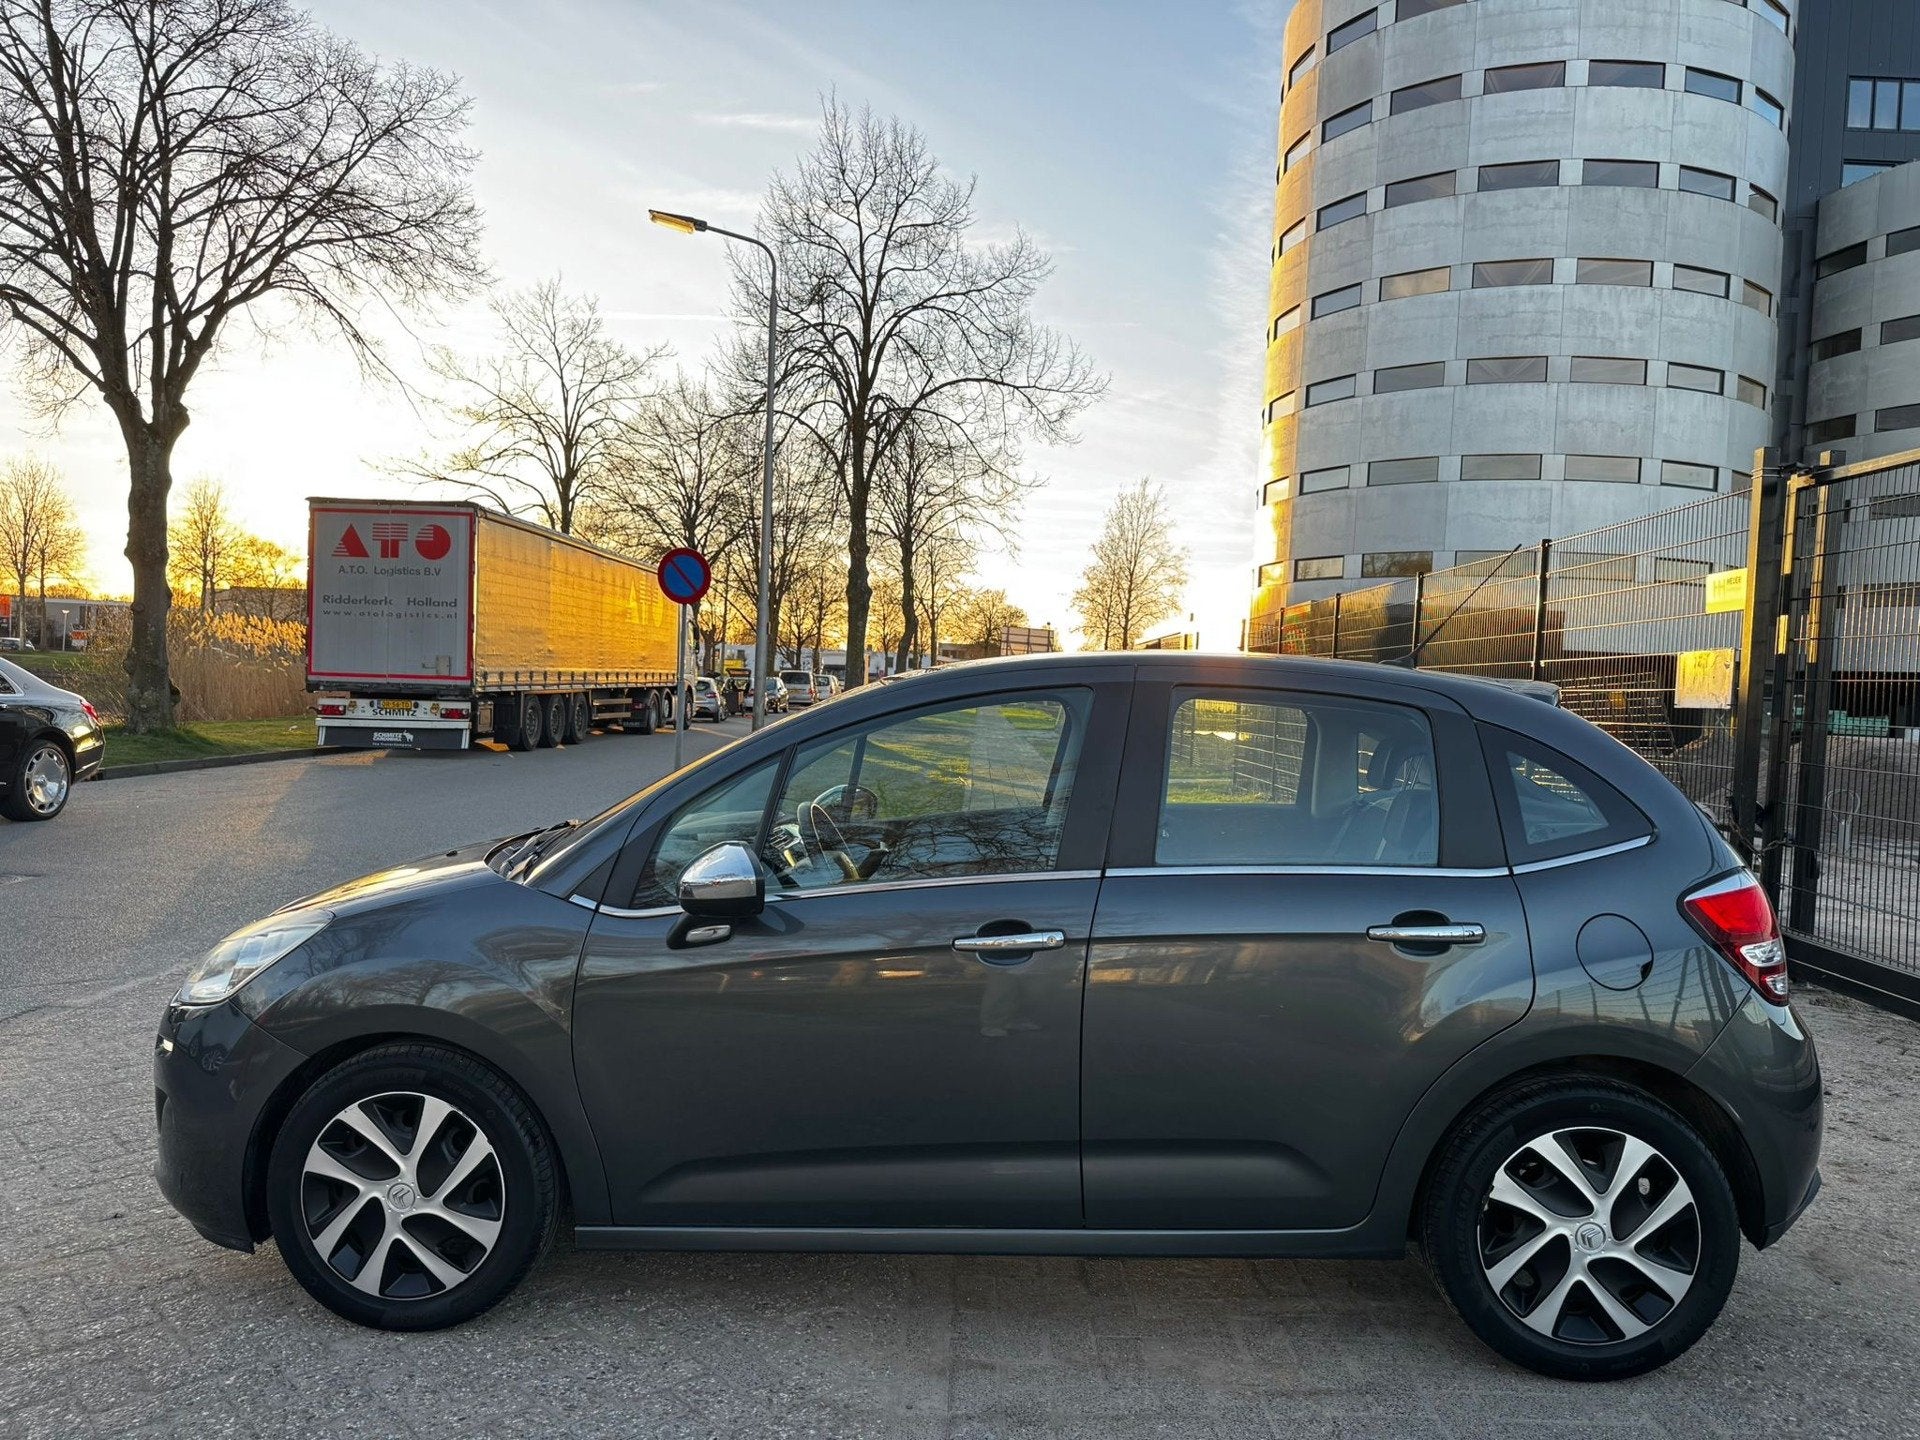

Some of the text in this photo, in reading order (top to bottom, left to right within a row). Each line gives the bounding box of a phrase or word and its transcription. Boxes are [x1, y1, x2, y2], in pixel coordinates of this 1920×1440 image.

[331, 522, 452, 560] ATO
[338, 565, 368, 575] A.T.O.
[373, 565, 421, 577] Logistics
[322, 594, 458, 608] Ridderkerk Holland
[322, 609, 458, 619] www.atologistics.nl
[372, 709, 417, 717] SCHMITZ
